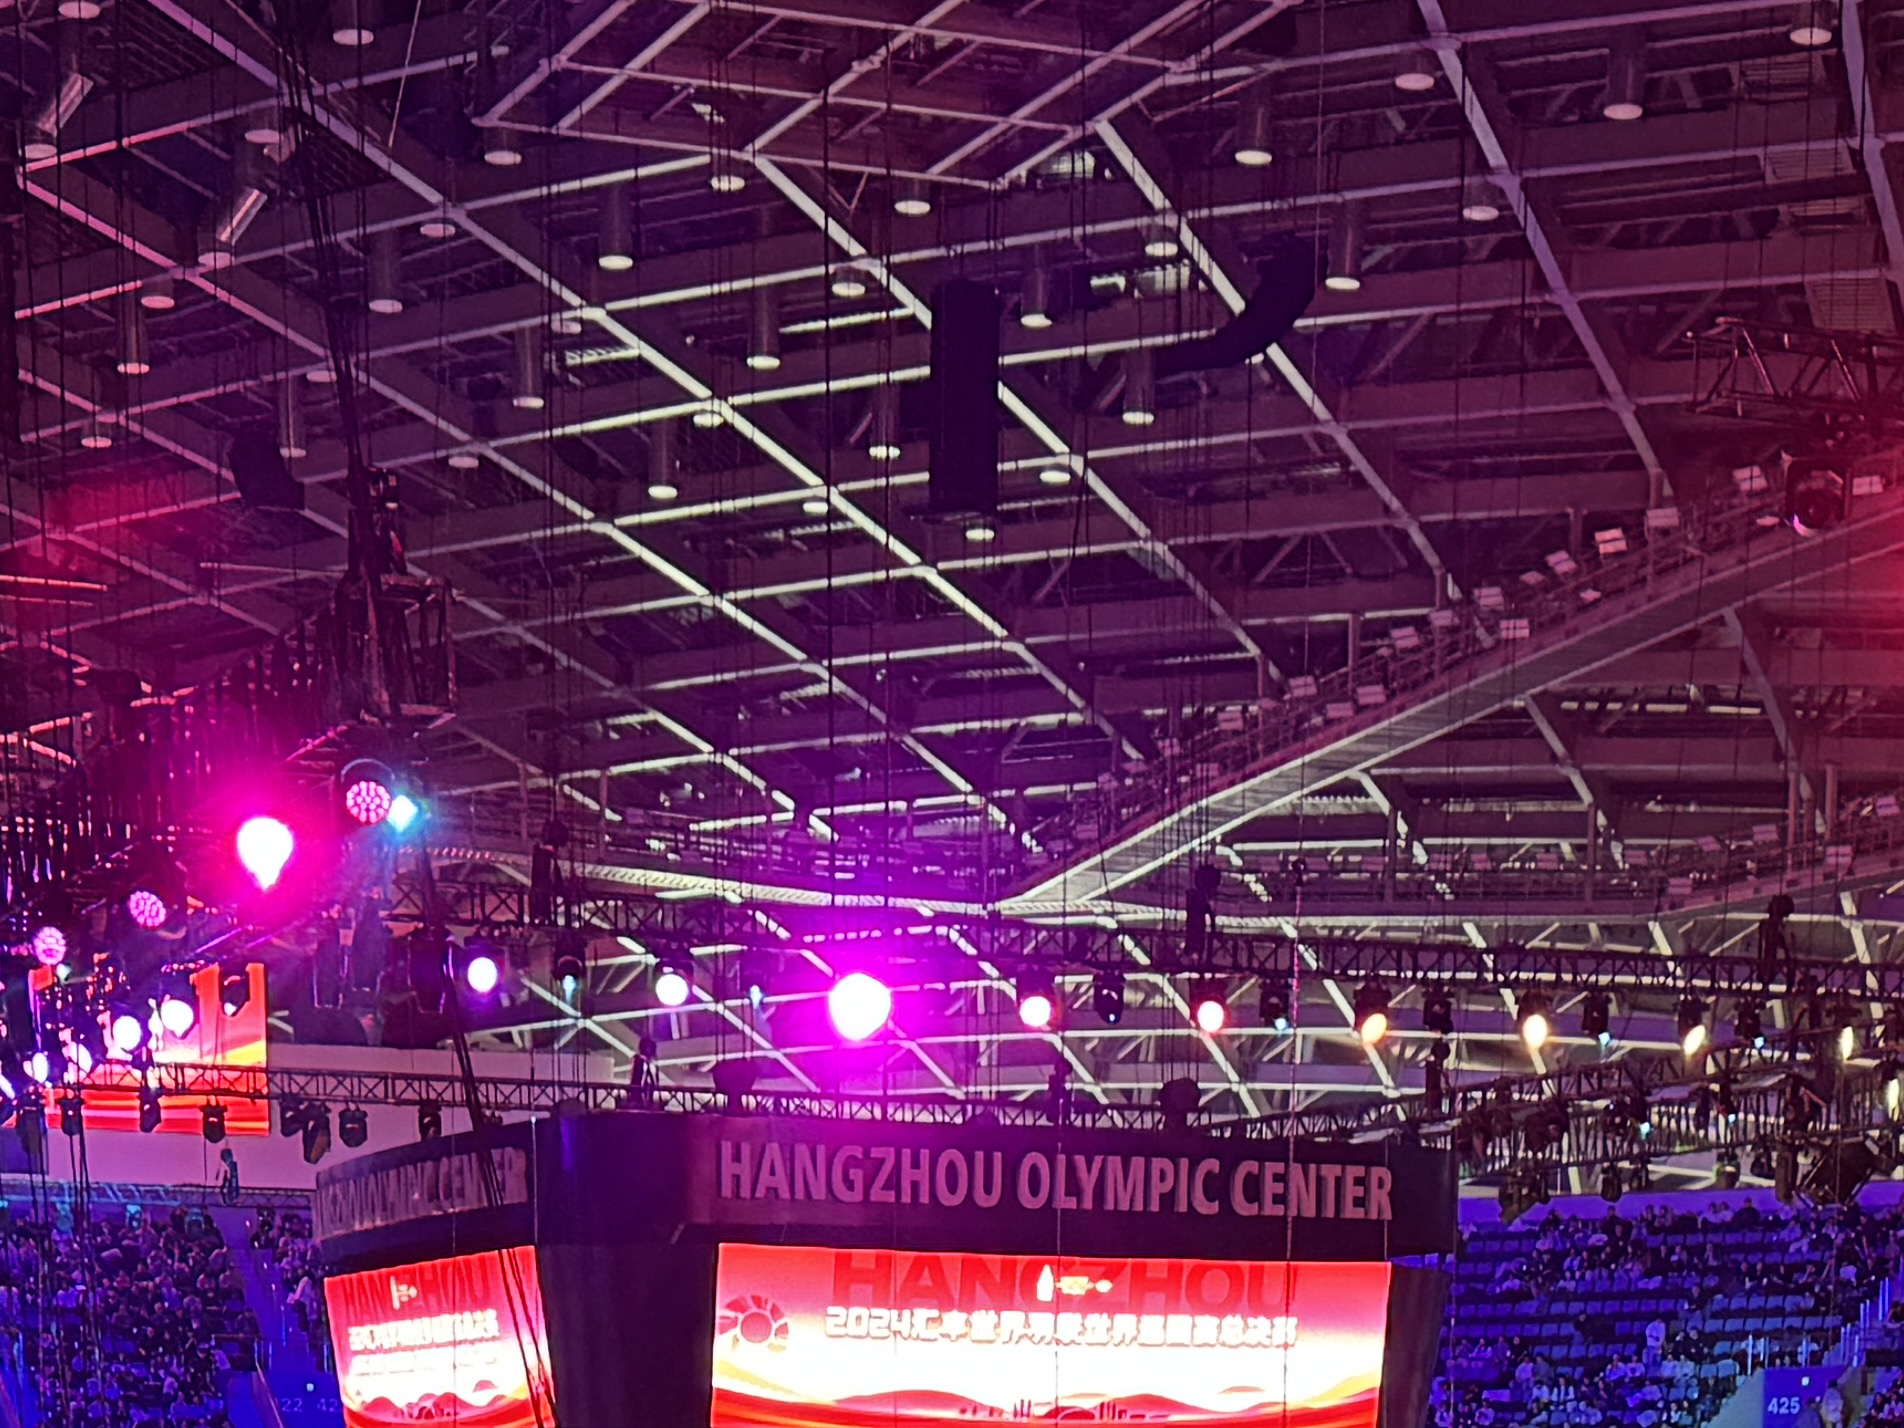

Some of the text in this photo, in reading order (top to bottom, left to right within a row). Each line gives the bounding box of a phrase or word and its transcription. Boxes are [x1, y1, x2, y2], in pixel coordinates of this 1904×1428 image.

[720, 1141, 1392, 1221] HANGZHOU OLYMPIC CENTER
[1767, 1396, 1800, 1414] 425
